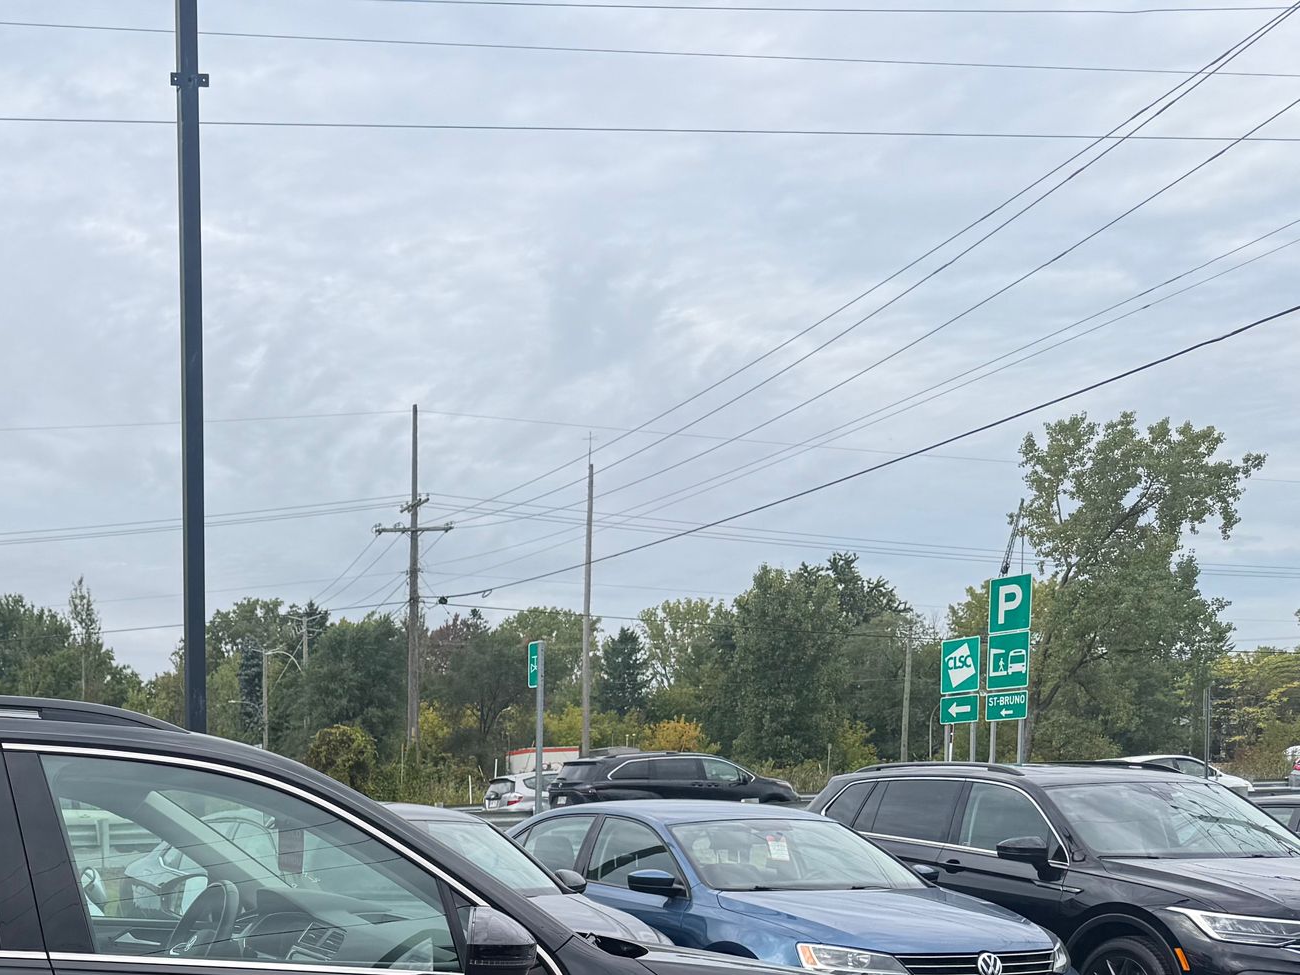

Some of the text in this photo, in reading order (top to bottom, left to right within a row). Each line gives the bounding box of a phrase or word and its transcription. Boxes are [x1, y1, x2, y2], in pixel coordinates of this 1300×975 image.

[998, 584, 1023, 625] P
[947, 655, 972, 671] CLSC
[988, 694, 1025, 707] ST-BRUNO
